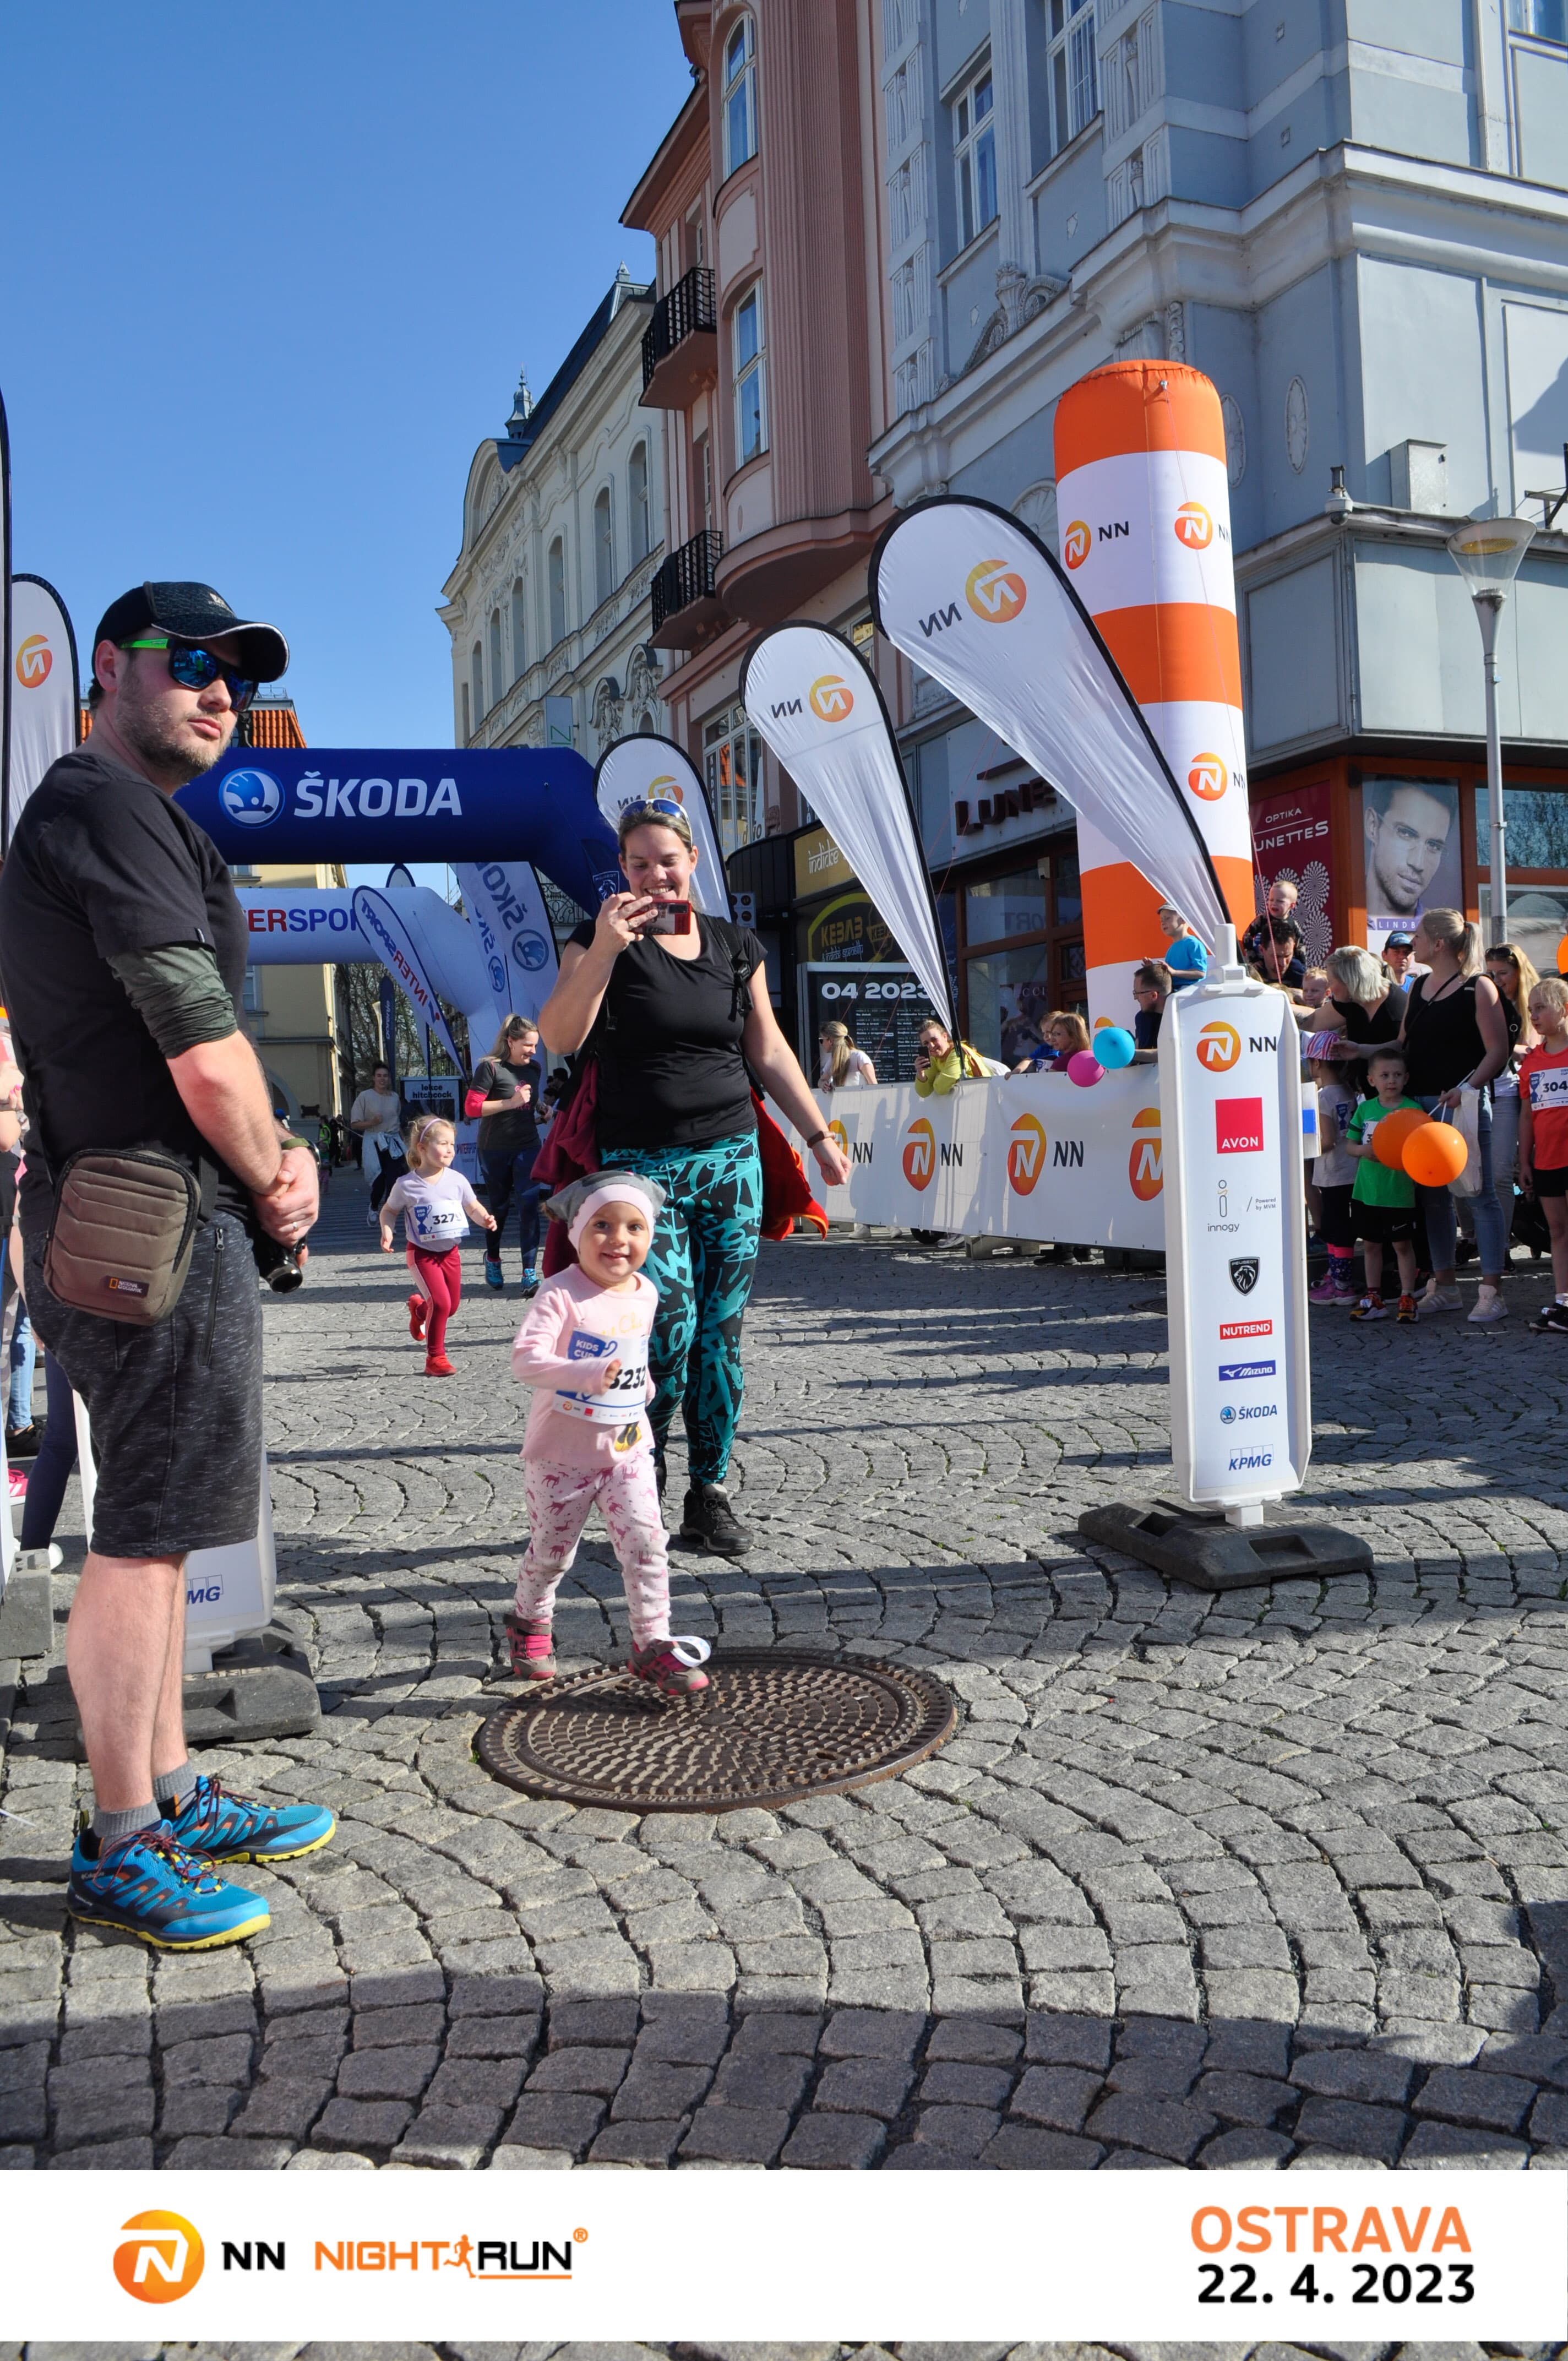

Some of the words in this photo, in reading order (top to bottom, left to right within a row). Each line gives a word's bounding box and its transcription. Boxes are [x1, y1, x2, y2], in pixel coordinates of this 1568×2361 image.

[1098, 521, 1129, 542] NN
[293, 770, 462, 818] ŠKODA
[1265, 807, 1302, 824] OPTIKA
[244, 909, 357, 932] ERSPO
[821, 982, 858, 999] 04
[864, 982, 931, 999] 2023
[1249, 1036, 1277, 1053] NN
[1221, 1136, 1259, 1149] AVON
[852, 1142, 873, 1163] NN
[940, 1143, 963, 1167] NN
[1053, 1140, 1084, 1167] NN
[1207, 1222, 1240, 1233] innogy
[1223, 1323, 1270, 1337] NUTREND
[576, 1339, 599, 1352] KIDS
[1239, 1405, 1277, 1420] ŠKODA
[1229, 1453, 1272, 1471] KPMG
